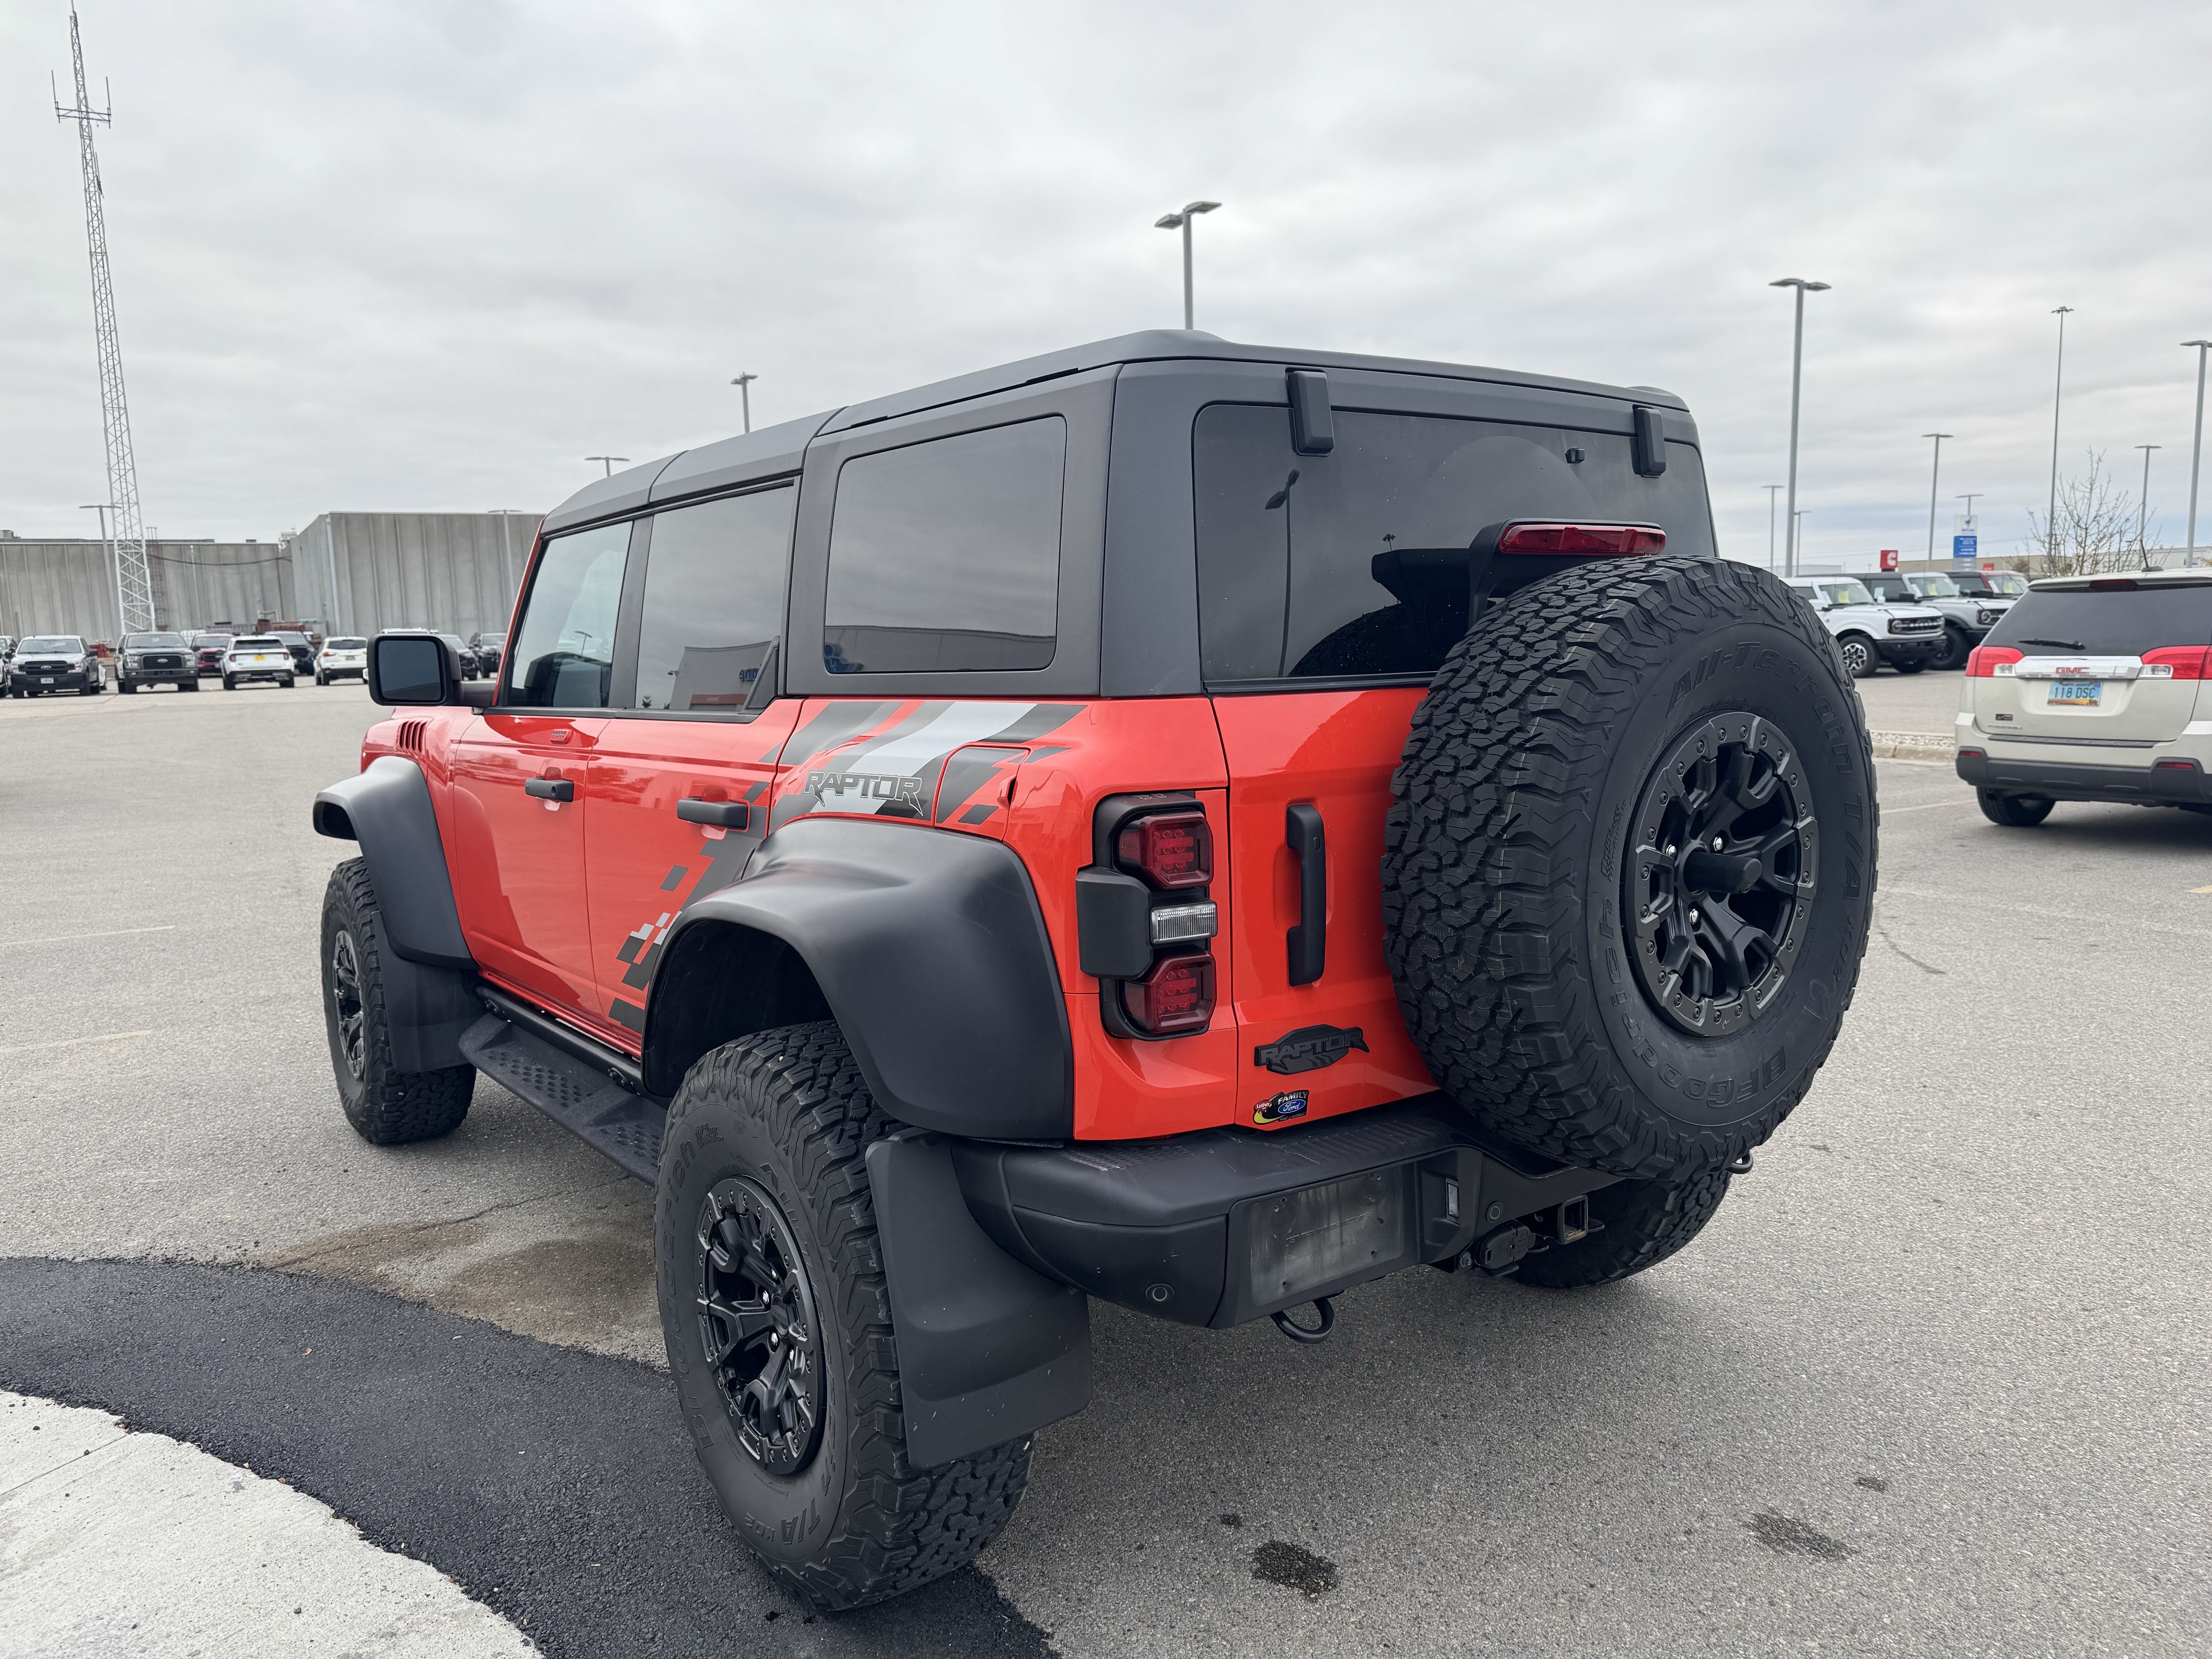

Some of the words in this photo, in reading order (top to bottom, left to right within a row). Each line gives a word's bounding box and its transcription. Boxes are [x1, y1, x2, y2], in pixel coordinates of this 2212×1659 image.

[2055, 687, 2073, 698] 118
[2075, 687, 2096, 698] DSC
[803, 771, 924, 817] RAPTOR
[1599, 898, 1788, 1108] BFGoodrich
[1260, 1027, 1370, 1070] RAPTOR
[1278, 1091, 1308, 1105] FAMILY
[1283, 1101, 1301, 1112] Ford
